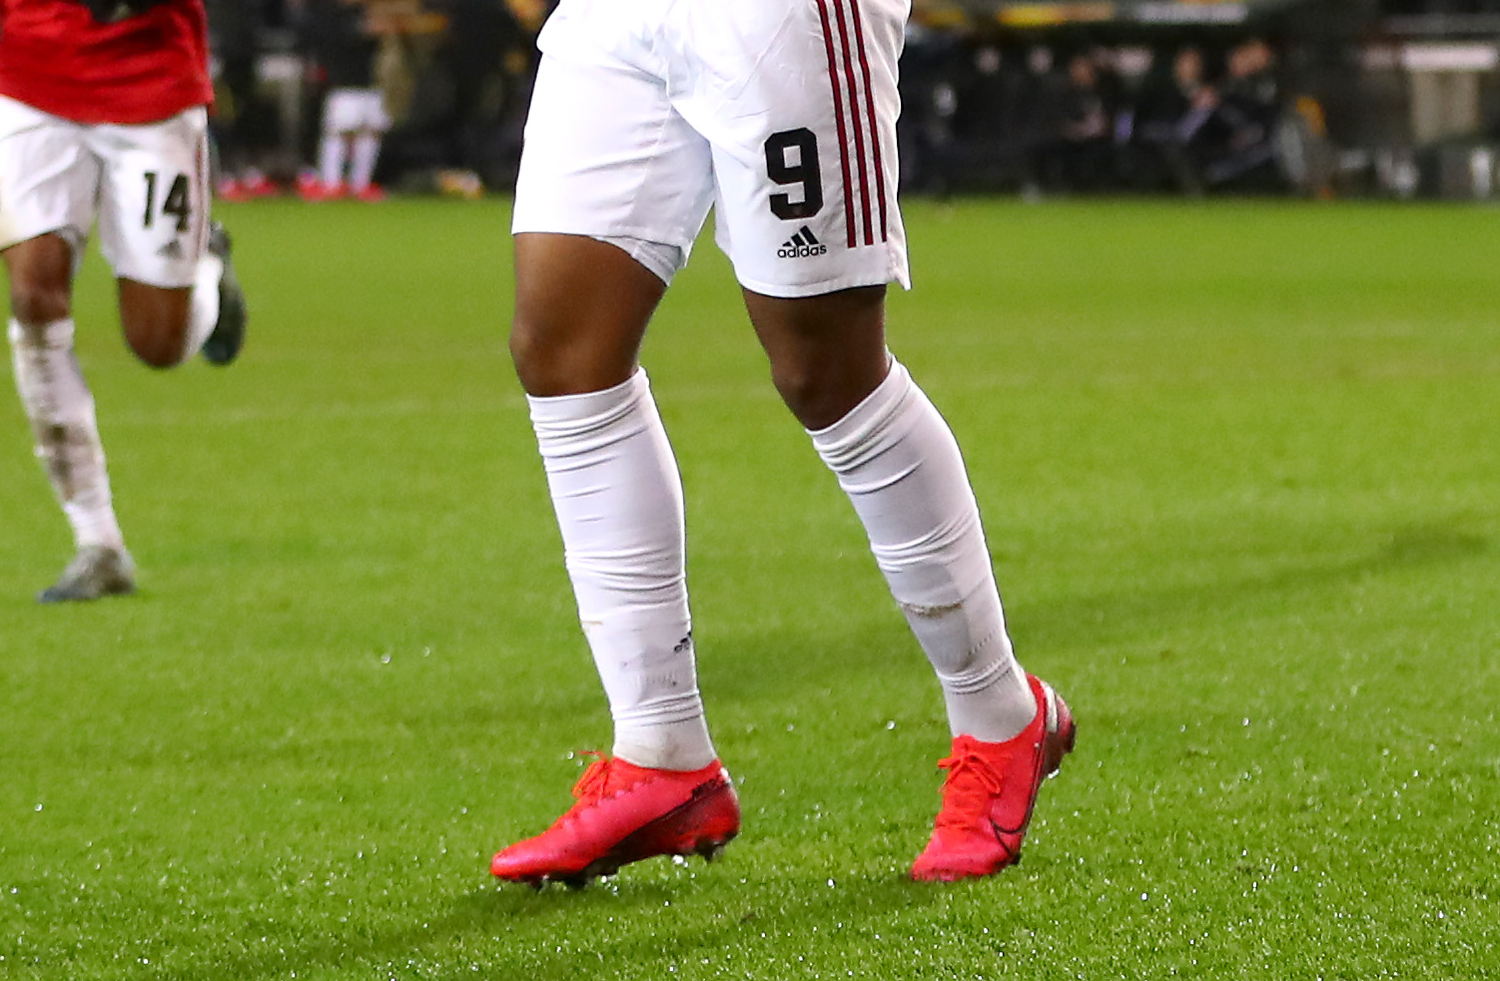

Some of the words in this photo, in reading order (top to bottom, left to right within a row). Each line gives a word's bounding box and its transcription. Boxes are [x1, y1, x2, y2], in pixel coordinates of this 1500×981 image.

[143, 172, 191, 232] 14
[764, 126, 824, 221] 9
[776, 244, 828, 258] adidas
